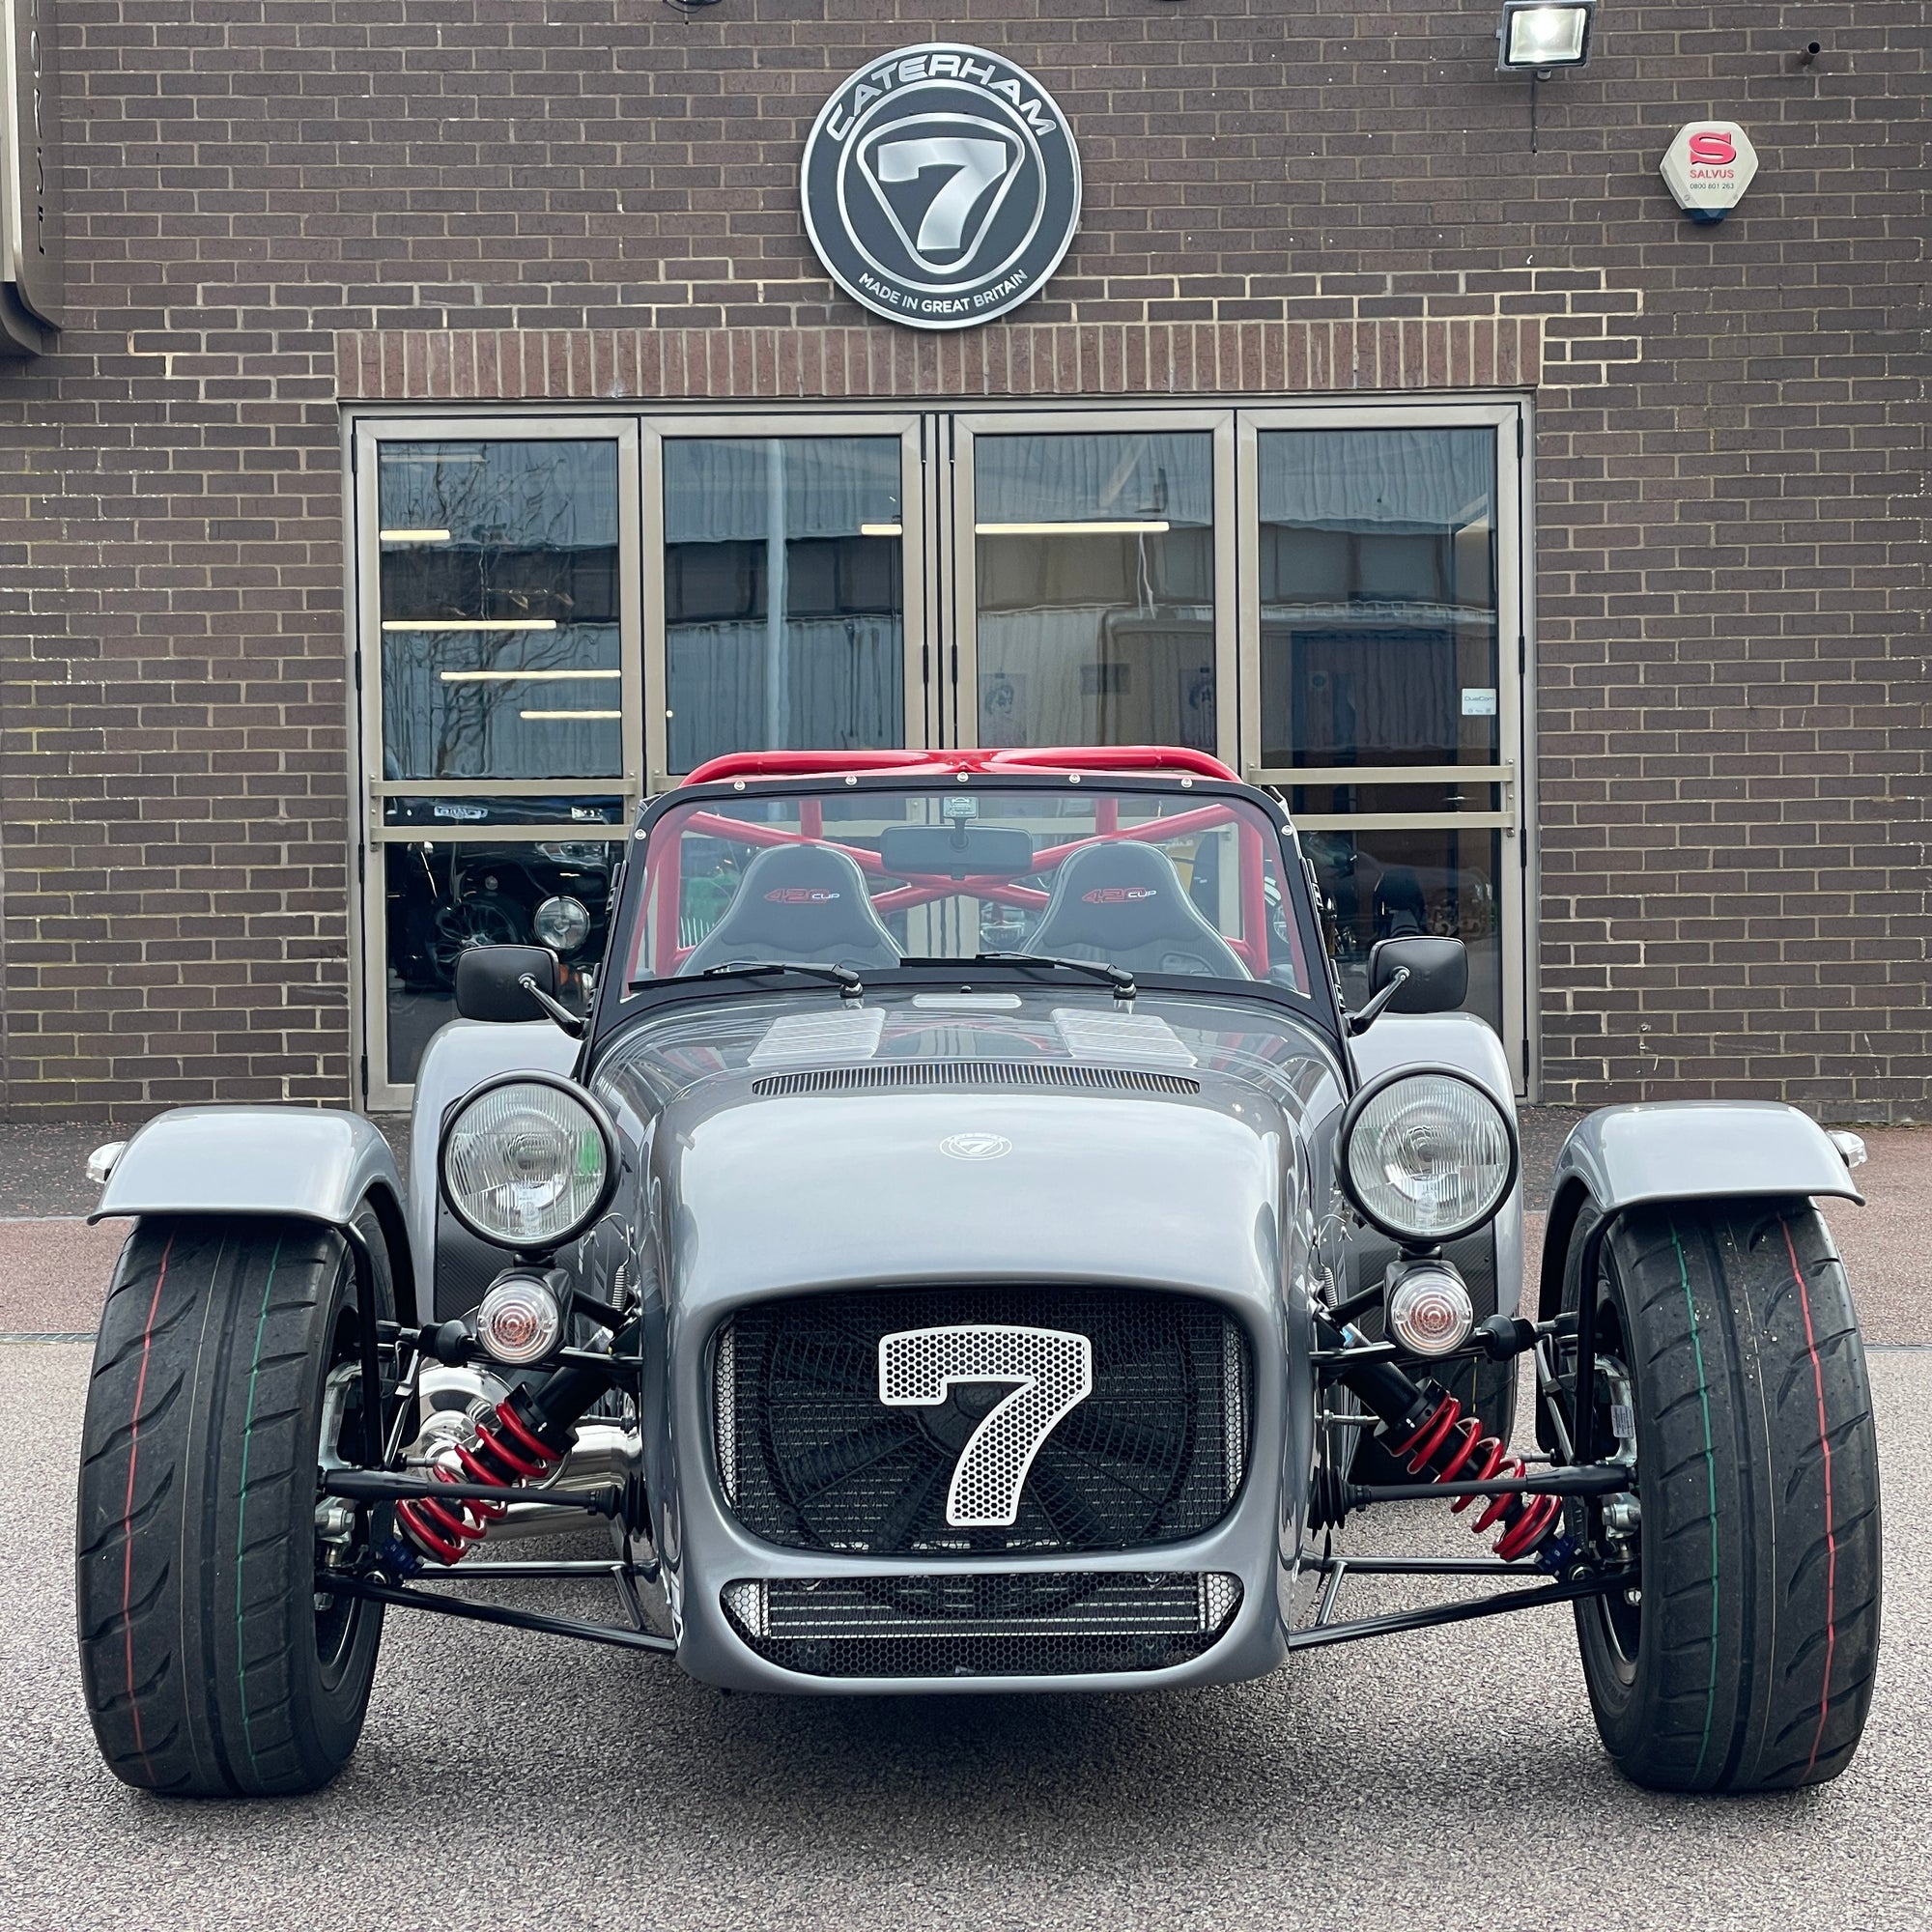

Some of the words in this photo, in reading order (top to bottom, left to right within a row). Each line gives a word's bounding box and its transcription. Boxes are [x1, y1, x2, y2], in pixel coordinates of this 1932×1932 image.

[826, 54, 1057, 141] CATERHAM
[877, 137, 1007, 250] 7
[1690, 169, 1734, 179] SALVUS
[858, 272, 901, 304] MADE
[901, 296, 919, 310] IN
[921, 298, 971, 313] GREAT
[973, 269, 1028, 307] BRITAIN
[1128, 890, 1157, 898] CUP
[879, 1324, 1092, 1526] 7
